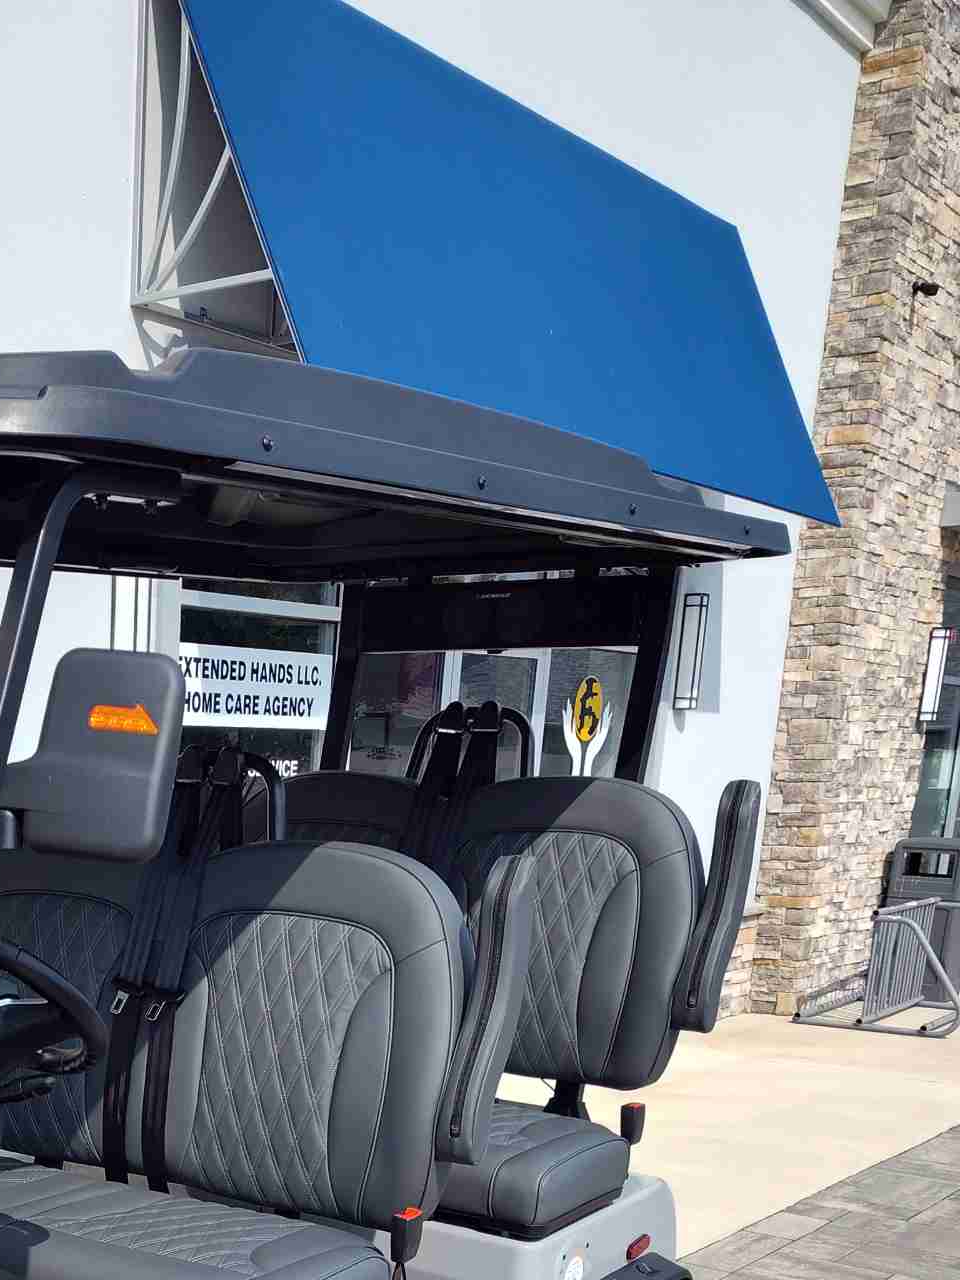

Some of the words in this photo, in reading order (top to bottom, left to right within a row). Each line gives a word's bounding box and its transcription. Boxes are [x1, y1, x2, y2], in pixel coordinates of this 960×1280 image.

[250, 661, 294, 685] HANDS
[297, 666, 323, 686] LLC.
[185, 691, 221, 714] HOME
[225, 693, 260, 715] CARE
[263, 695, 314, 718] AGENCY
